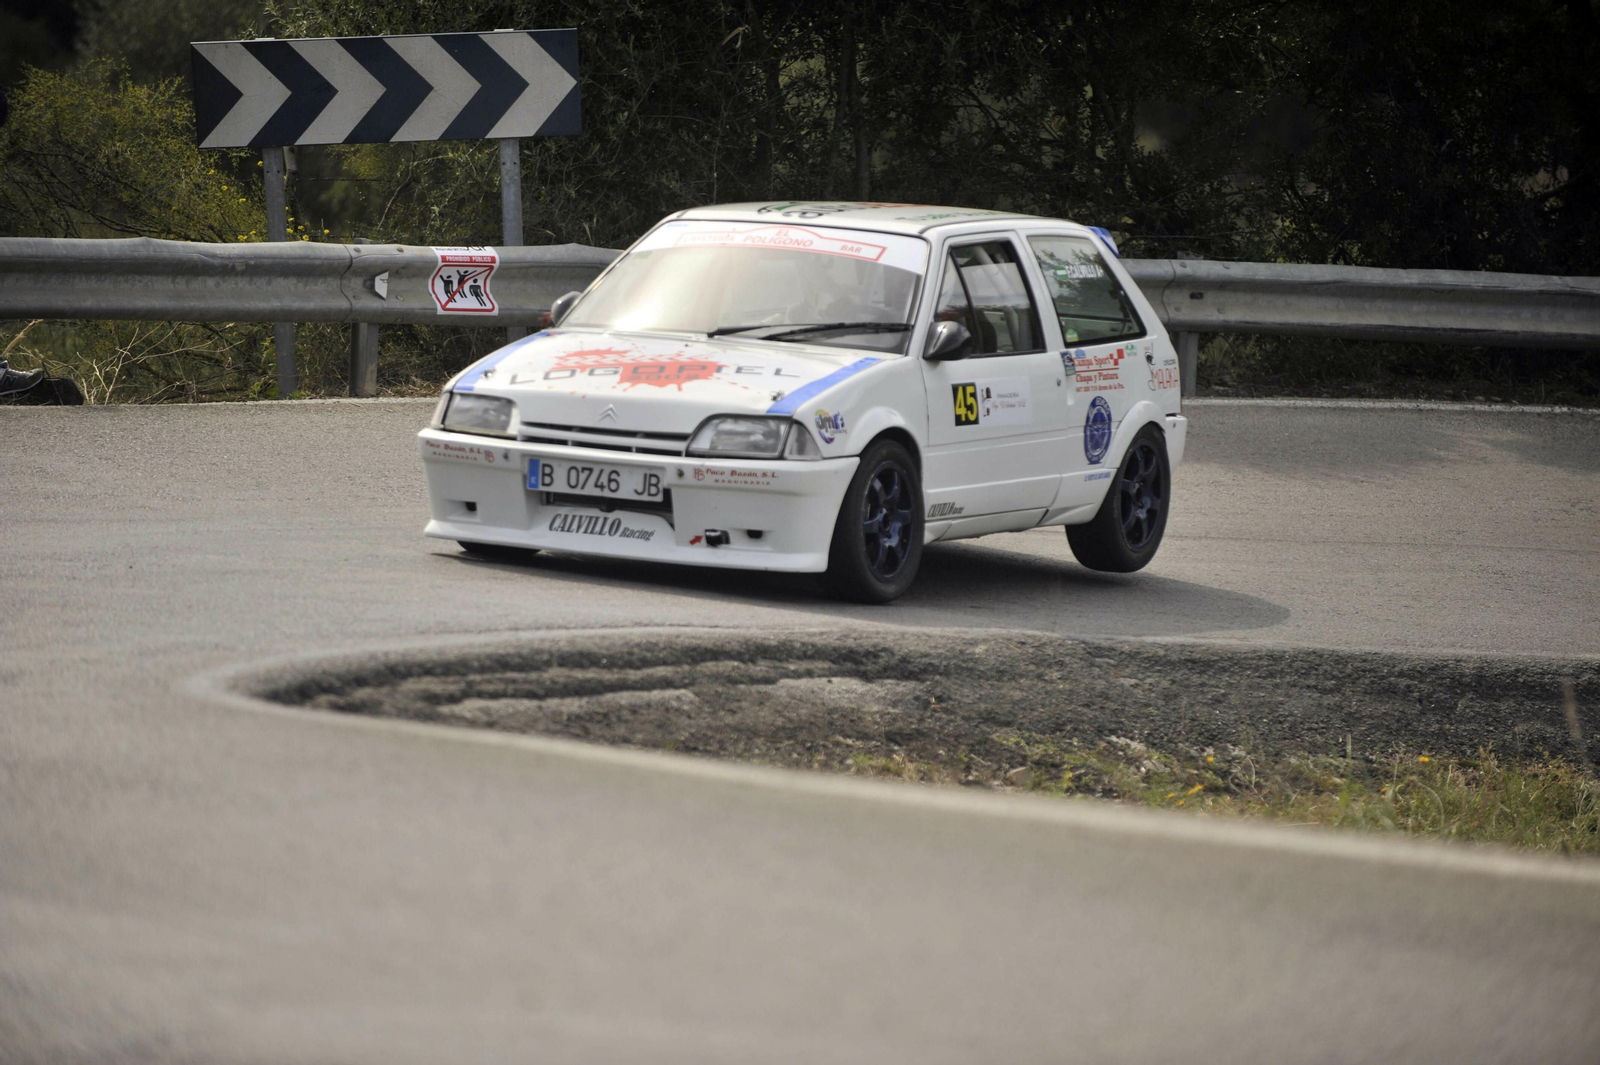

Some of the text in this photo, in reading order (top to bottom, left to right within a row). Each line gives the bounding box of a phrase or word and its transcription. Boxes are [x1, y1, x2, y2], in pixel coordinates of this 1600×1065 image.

[775, 229, 790, 237] EL
[744, 235, 813, 247] POLIGONO
[840, 244, 862, 254] BAR
[1094, 356, 1111, 367] Sport
[1098, 372, 1119, 381] Pintura
[955, 385, 977, 421] 45
[541, 463, 660, 497] B 0746 JB
[706, 468, 725, 476] Paco
[927, 501, 955, 518] CALVILLO
[549, 513, 656, 542] CALVILLO Racing
